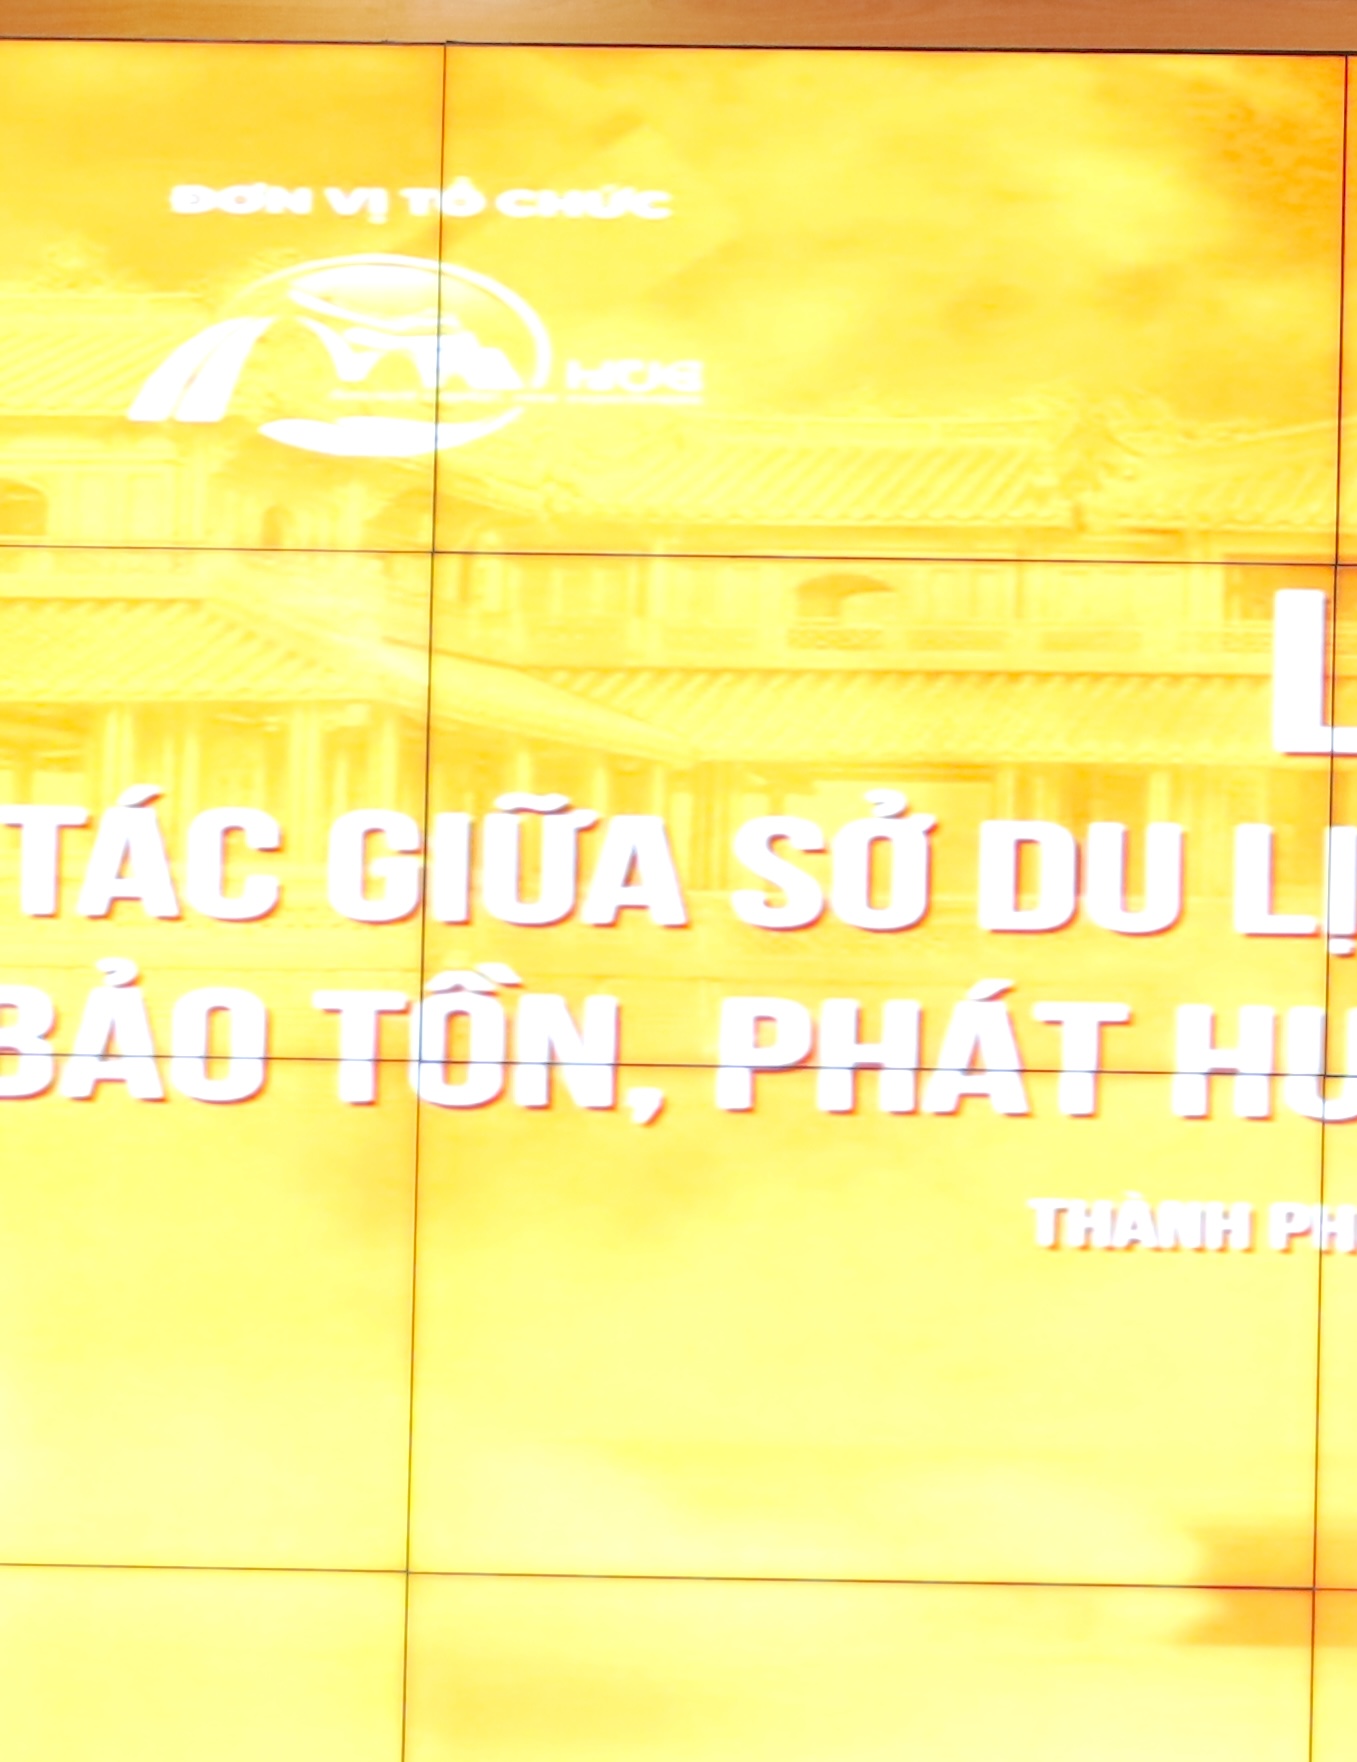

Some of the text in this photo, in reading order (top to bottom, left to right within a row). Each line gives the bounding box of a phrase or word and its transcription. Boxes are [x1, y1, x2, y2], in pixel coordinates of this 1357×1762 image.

[170, 183, 312, 214] ĐƠN
[325, 188, 388, 223] VỊ
[0, 784, 280, 919] TÁC
[325, 792, 687, 925] GIỮA
[730, 788, 936, 929] SỞ
[978, 820, 1183, 933] DU
[311, 962, 663, 1123] TỒN,
[715, 978, 1130, 1115] PHÁT
[1027, 1191, 1252, 1249] THÀNH
